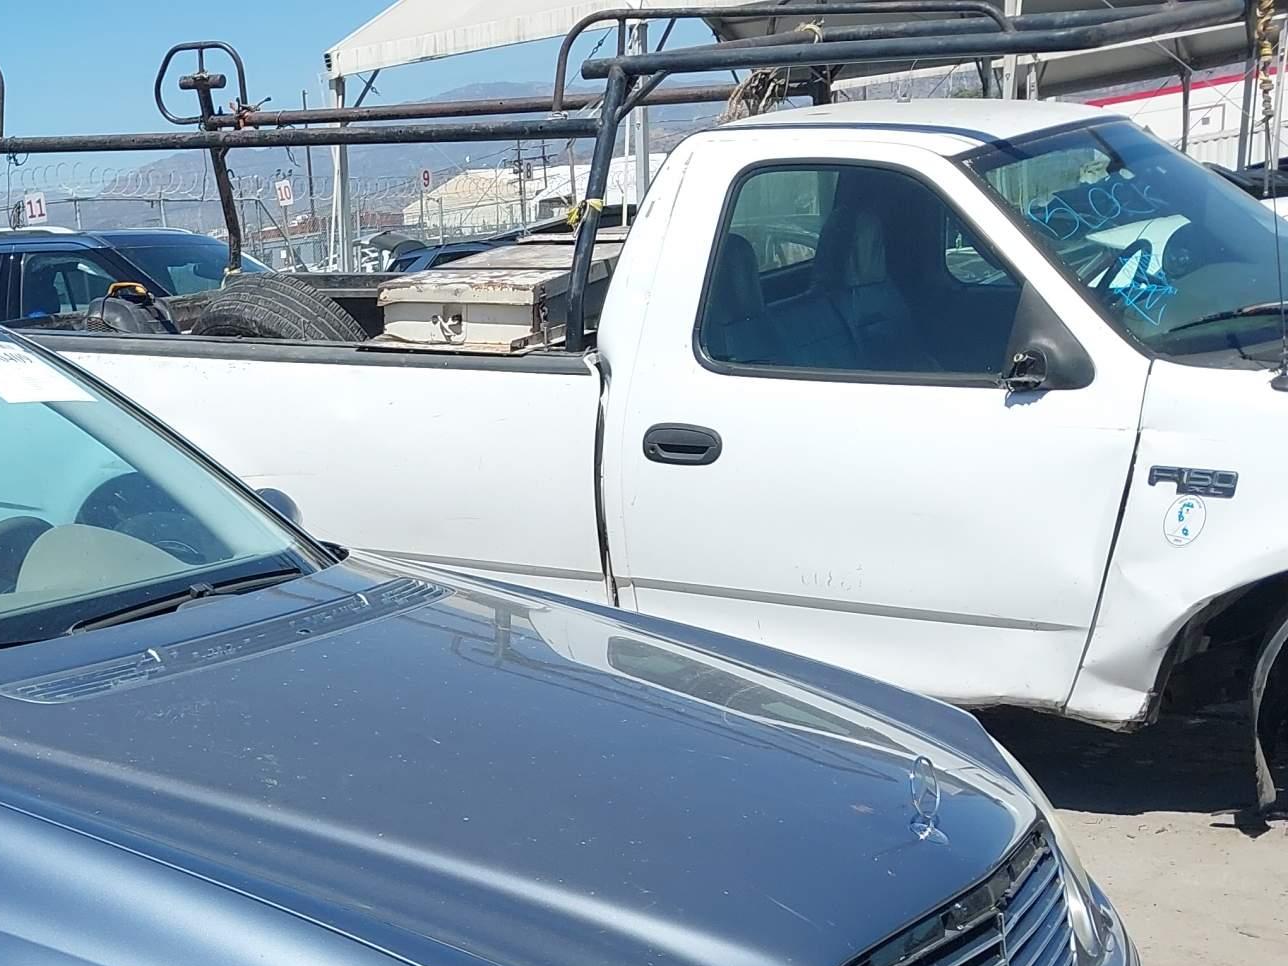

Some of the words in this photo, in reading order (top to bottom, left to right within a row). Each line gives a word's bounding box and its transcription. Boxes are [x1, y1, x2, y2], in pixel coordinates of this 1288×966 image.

[422, 170, 430, 187] 9
[278, 185, 292, 201] 10
[27, 198, 46, 218] 11
